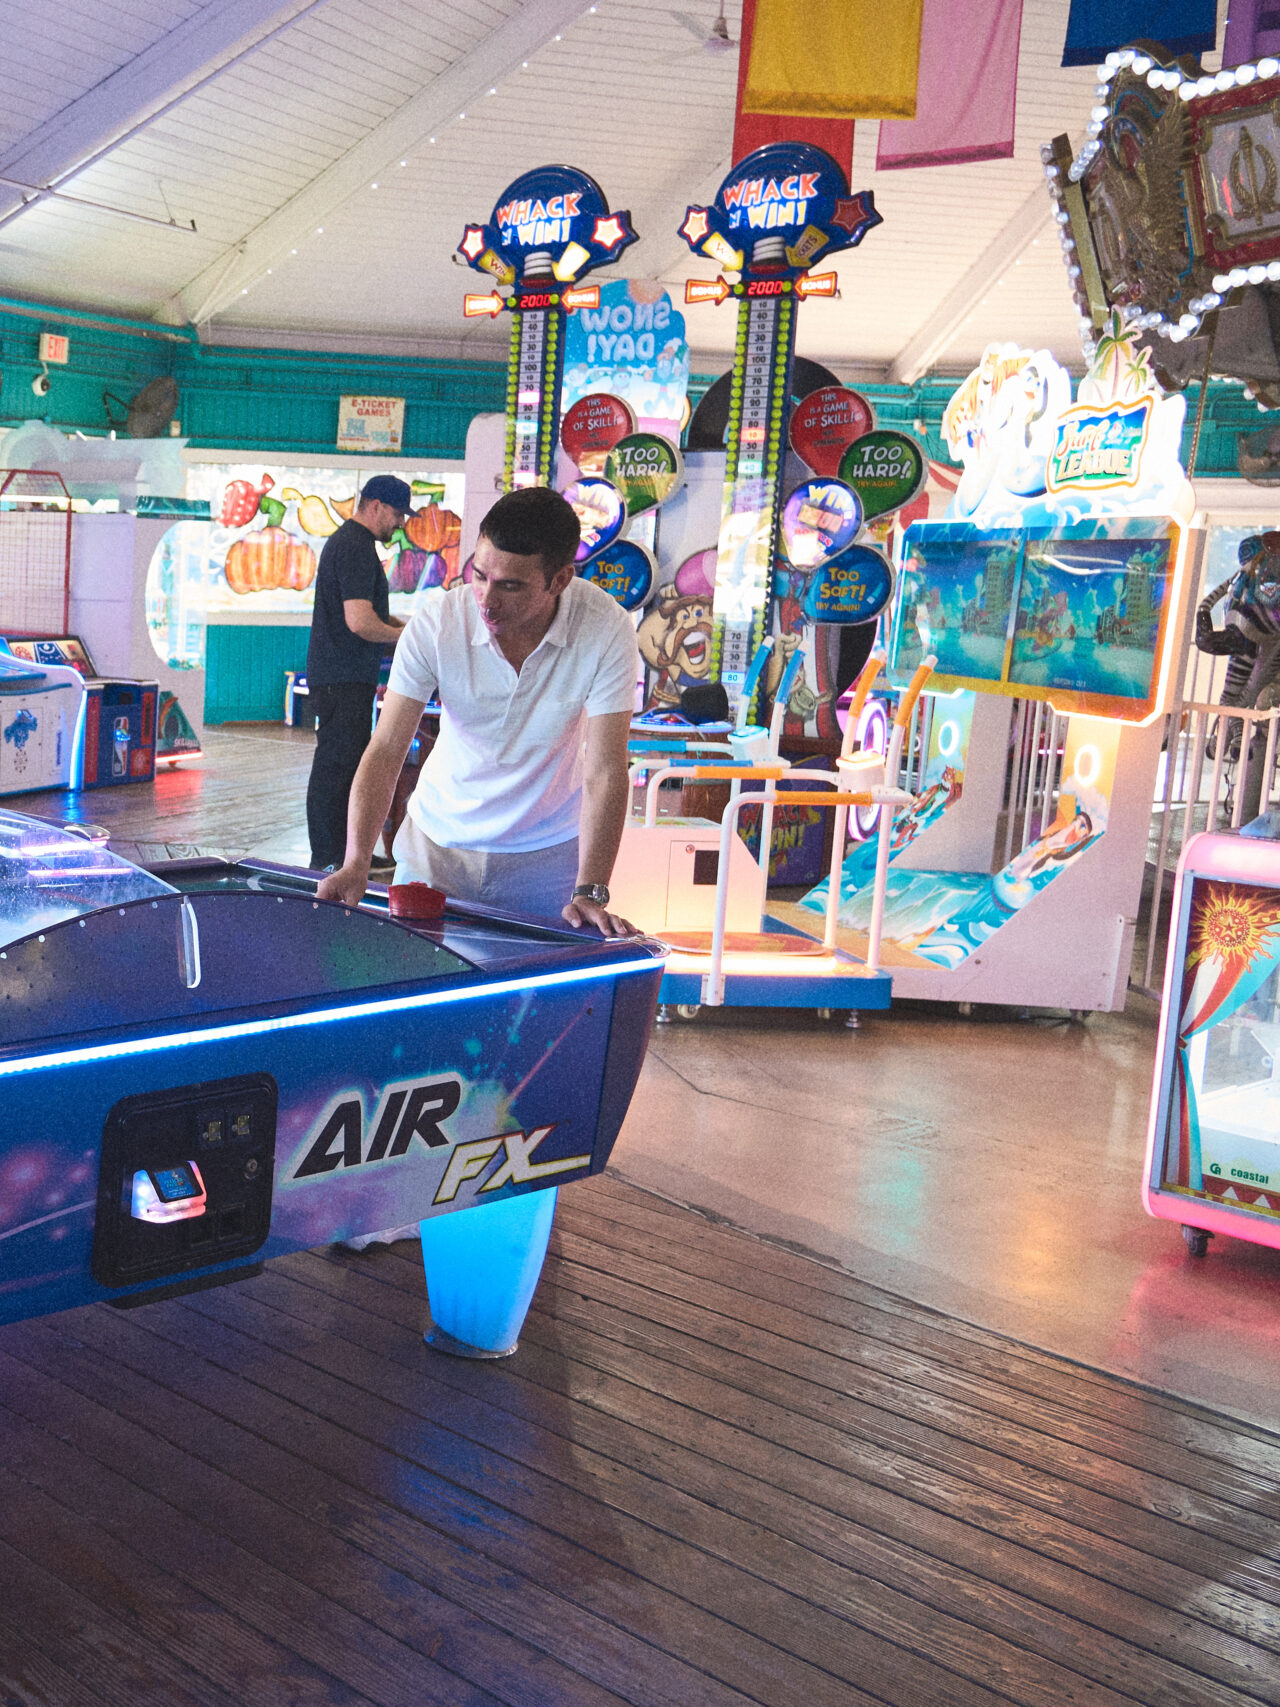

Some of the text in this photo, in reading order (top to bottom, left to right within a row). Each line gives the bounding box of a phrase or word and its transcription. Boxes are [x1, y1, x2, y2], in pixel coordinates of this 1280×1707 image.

[723, 172, 820, 210] WHACK
[496, 193, 582, 229] WHACK
[747, 200, 807, 229] WIN!
[517, 218, 571, 246] WIN!
[748, 282, 783, 296] 2000
[520, 294, 551, 308] 2000
[48, 336, 64, 360] EXIT
[352, 398, 397, 409] E-TICKET
[821, 393, 836, 402] THIS
[356, 408, 392, 417] GAMES
[590, 406, 611, 417] GAME
[823, 402, 848, 413] GAME
[573, 416, 617, 432] OF SKILL!
[804, 412, 855, 428] OF SKILL!
[623, 446, 658, 464] TOO
[861, 445, 902, 463] TOO
[616, 461, 667, 478] HARD!
[853, 460, 912, 480] HARD!
[291, 1079, 461, 1181] AIR
[431, 1121, 591, 1207] FX
[1230, 1168, 1270, 1185] coastal
